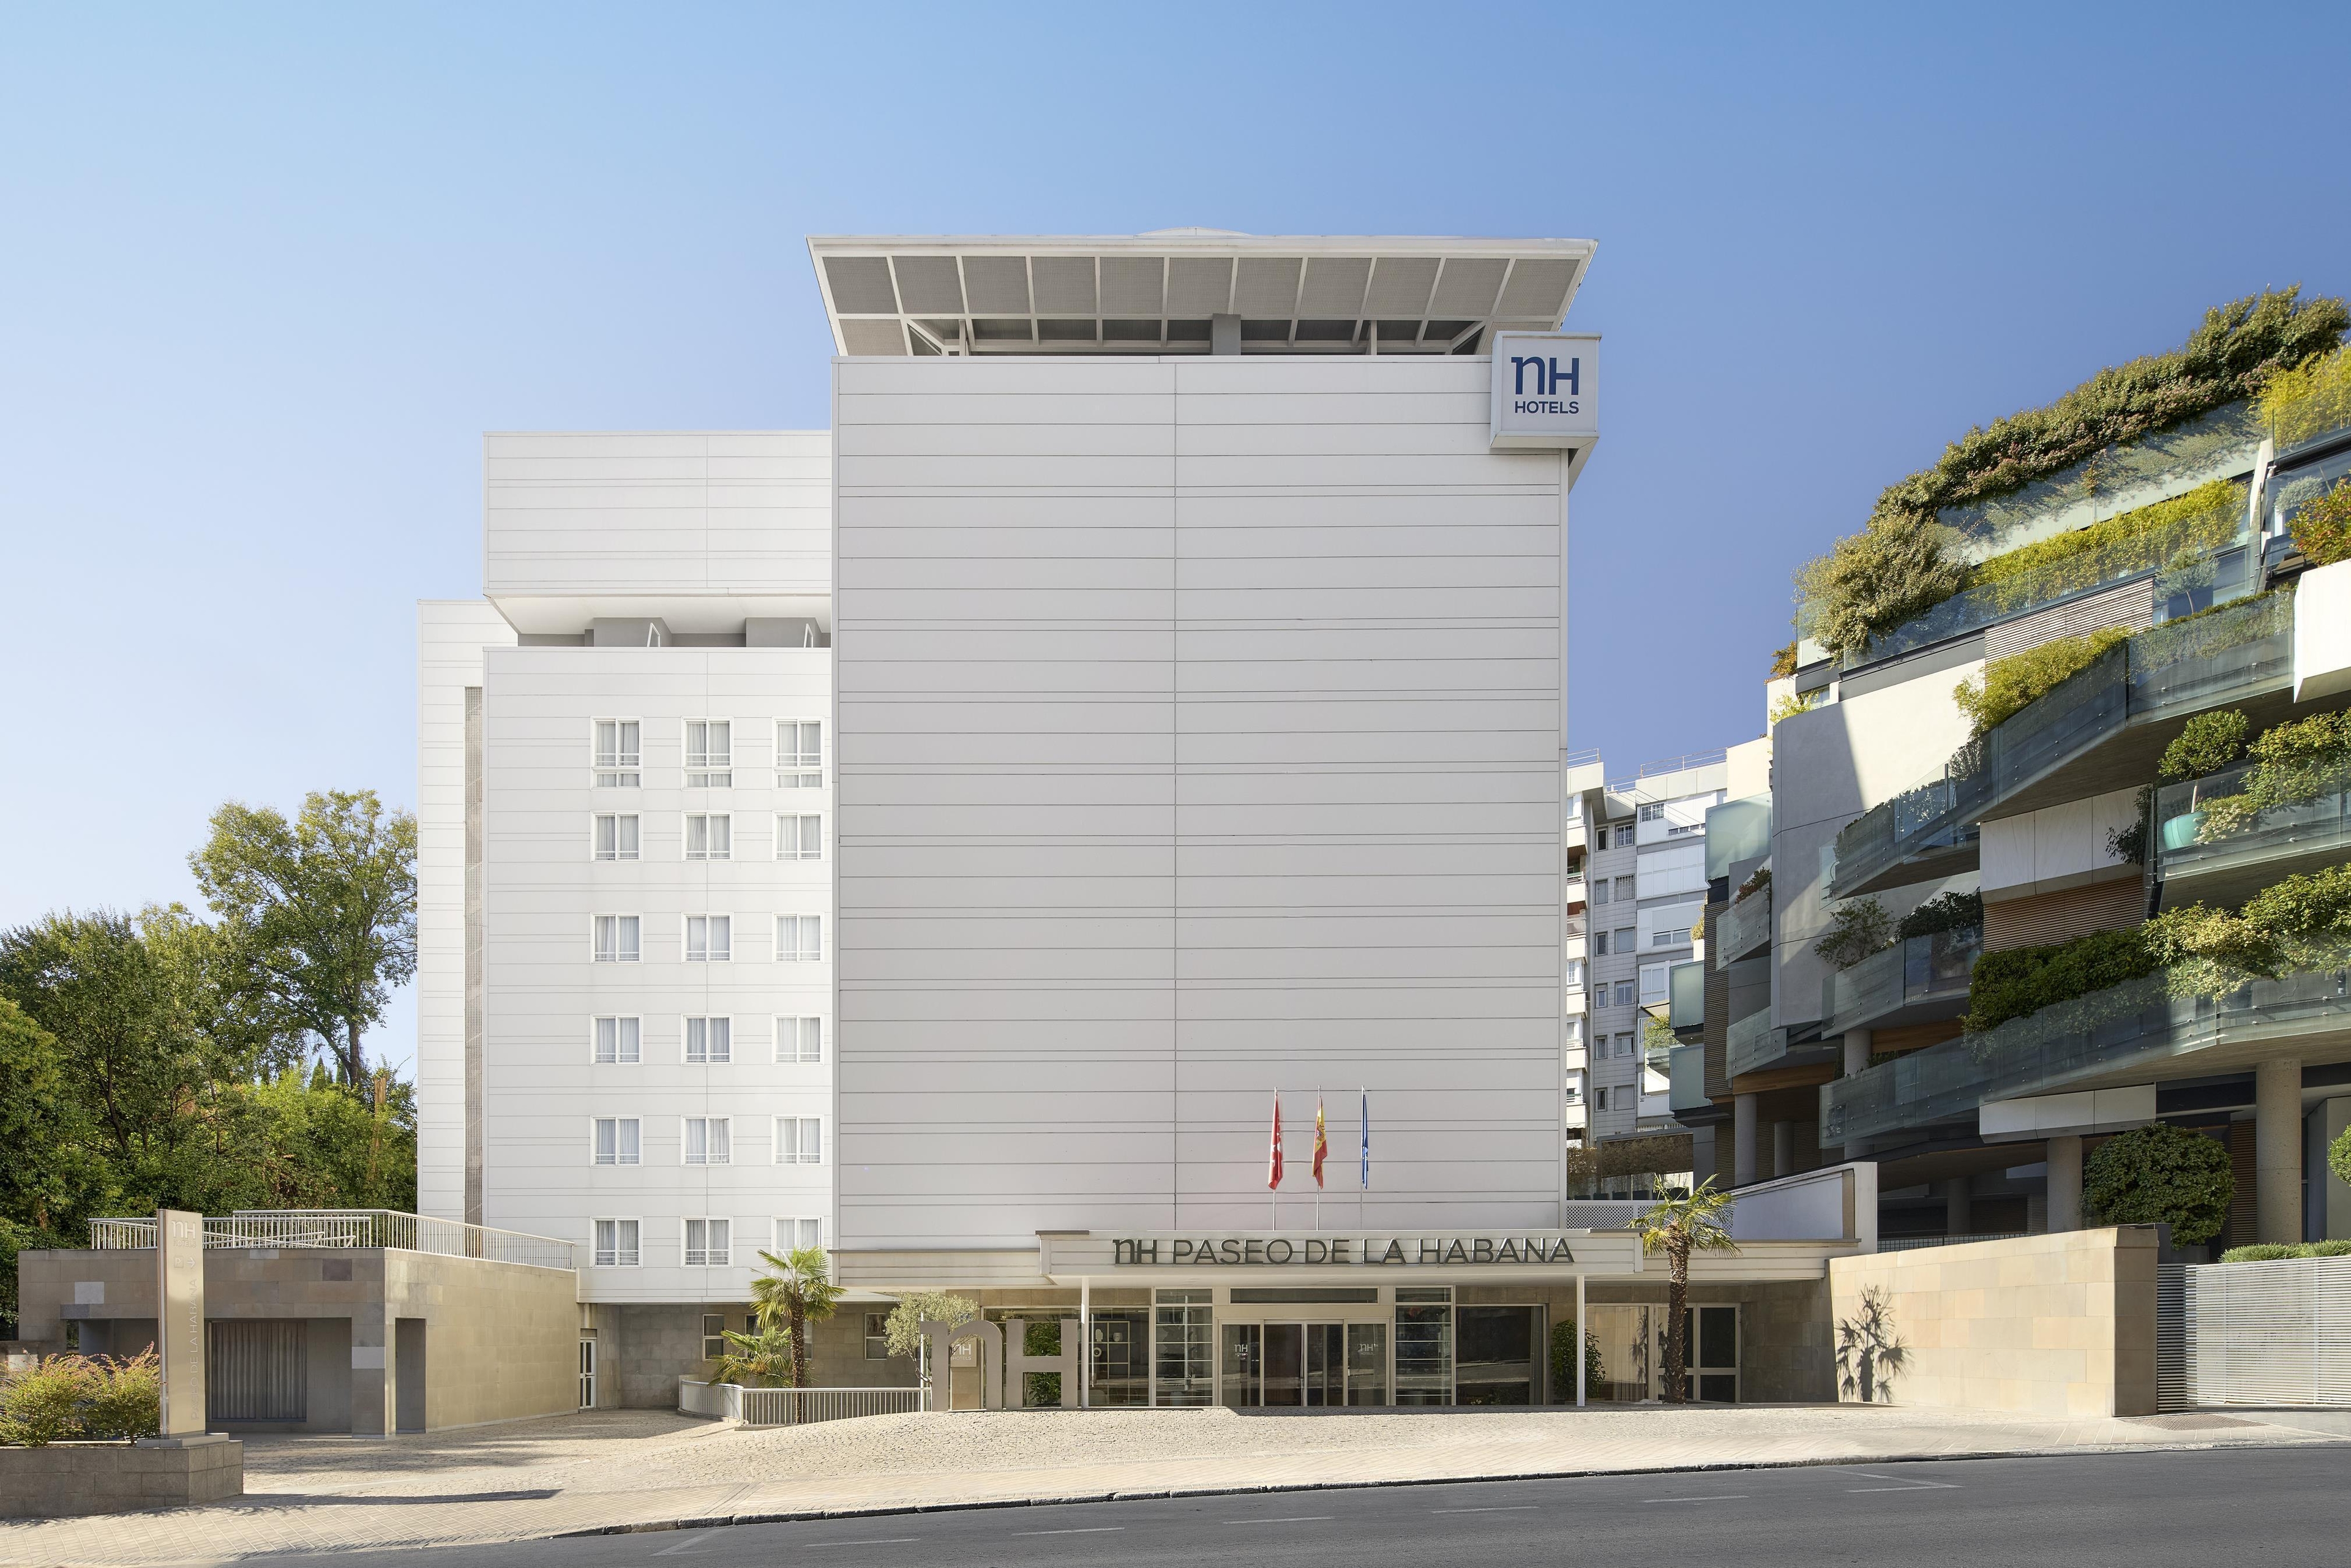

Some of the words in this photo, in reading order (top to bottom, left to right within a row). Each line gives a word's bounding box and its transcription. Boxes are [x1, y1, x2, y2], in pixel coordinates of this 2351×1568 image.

[1515, 400, 1580, 414] HOTELS
[173, 1239, 197, 1248] HOTELS
[1172, 1238, 1293, 1265] PASEO
[1305, 1238, 1349, 1264] DE
[1362, 1237, 1407, 1264] LA
[1418, 1237, 1575, 1264] HABANA
[190, 1337, 198, 1352] LA
[190, 1356, 198, 1373] DE
[190, 1377, 199, 1420] PASEO
